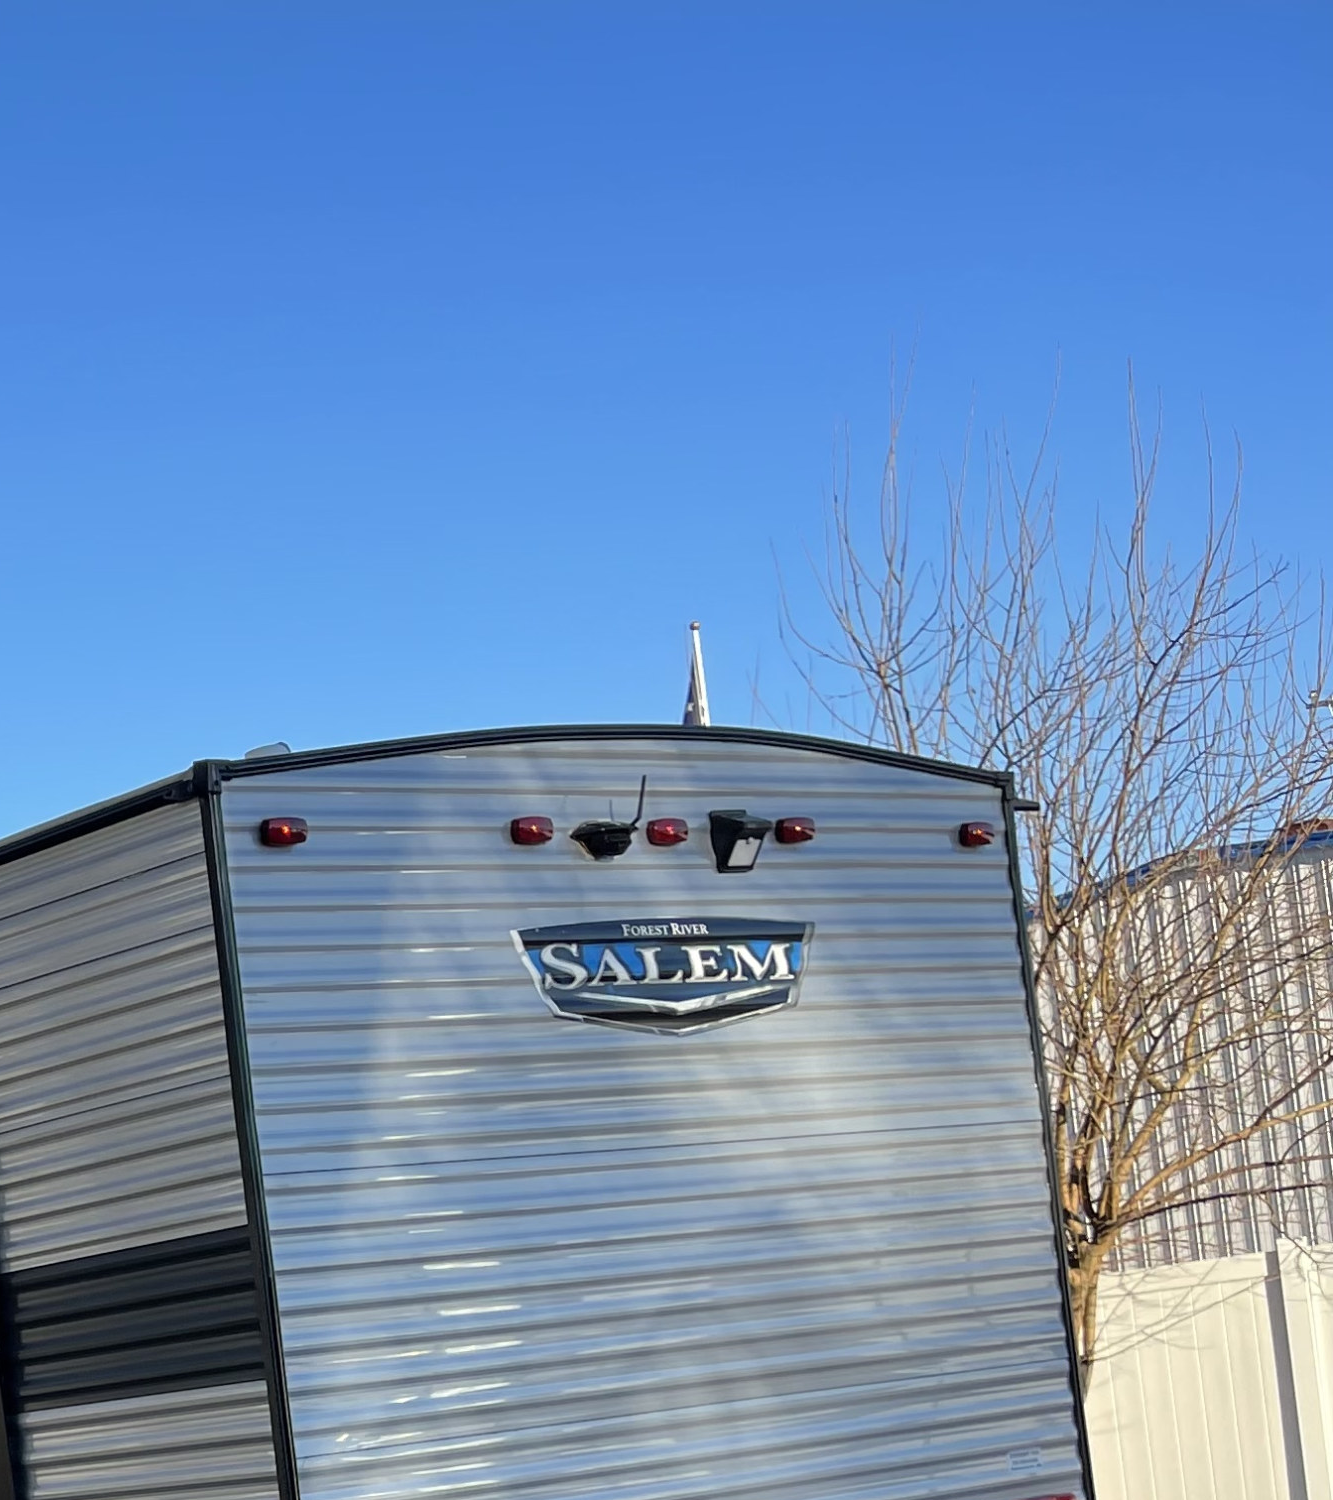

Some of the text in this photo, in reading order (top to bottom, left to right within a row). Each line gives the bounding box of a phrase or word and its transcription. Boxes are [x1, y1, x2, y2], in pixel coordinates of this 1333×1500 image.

[621, 922, 709, 937] FOREST RIVER
[538, 941, 796, 990] SALEM
